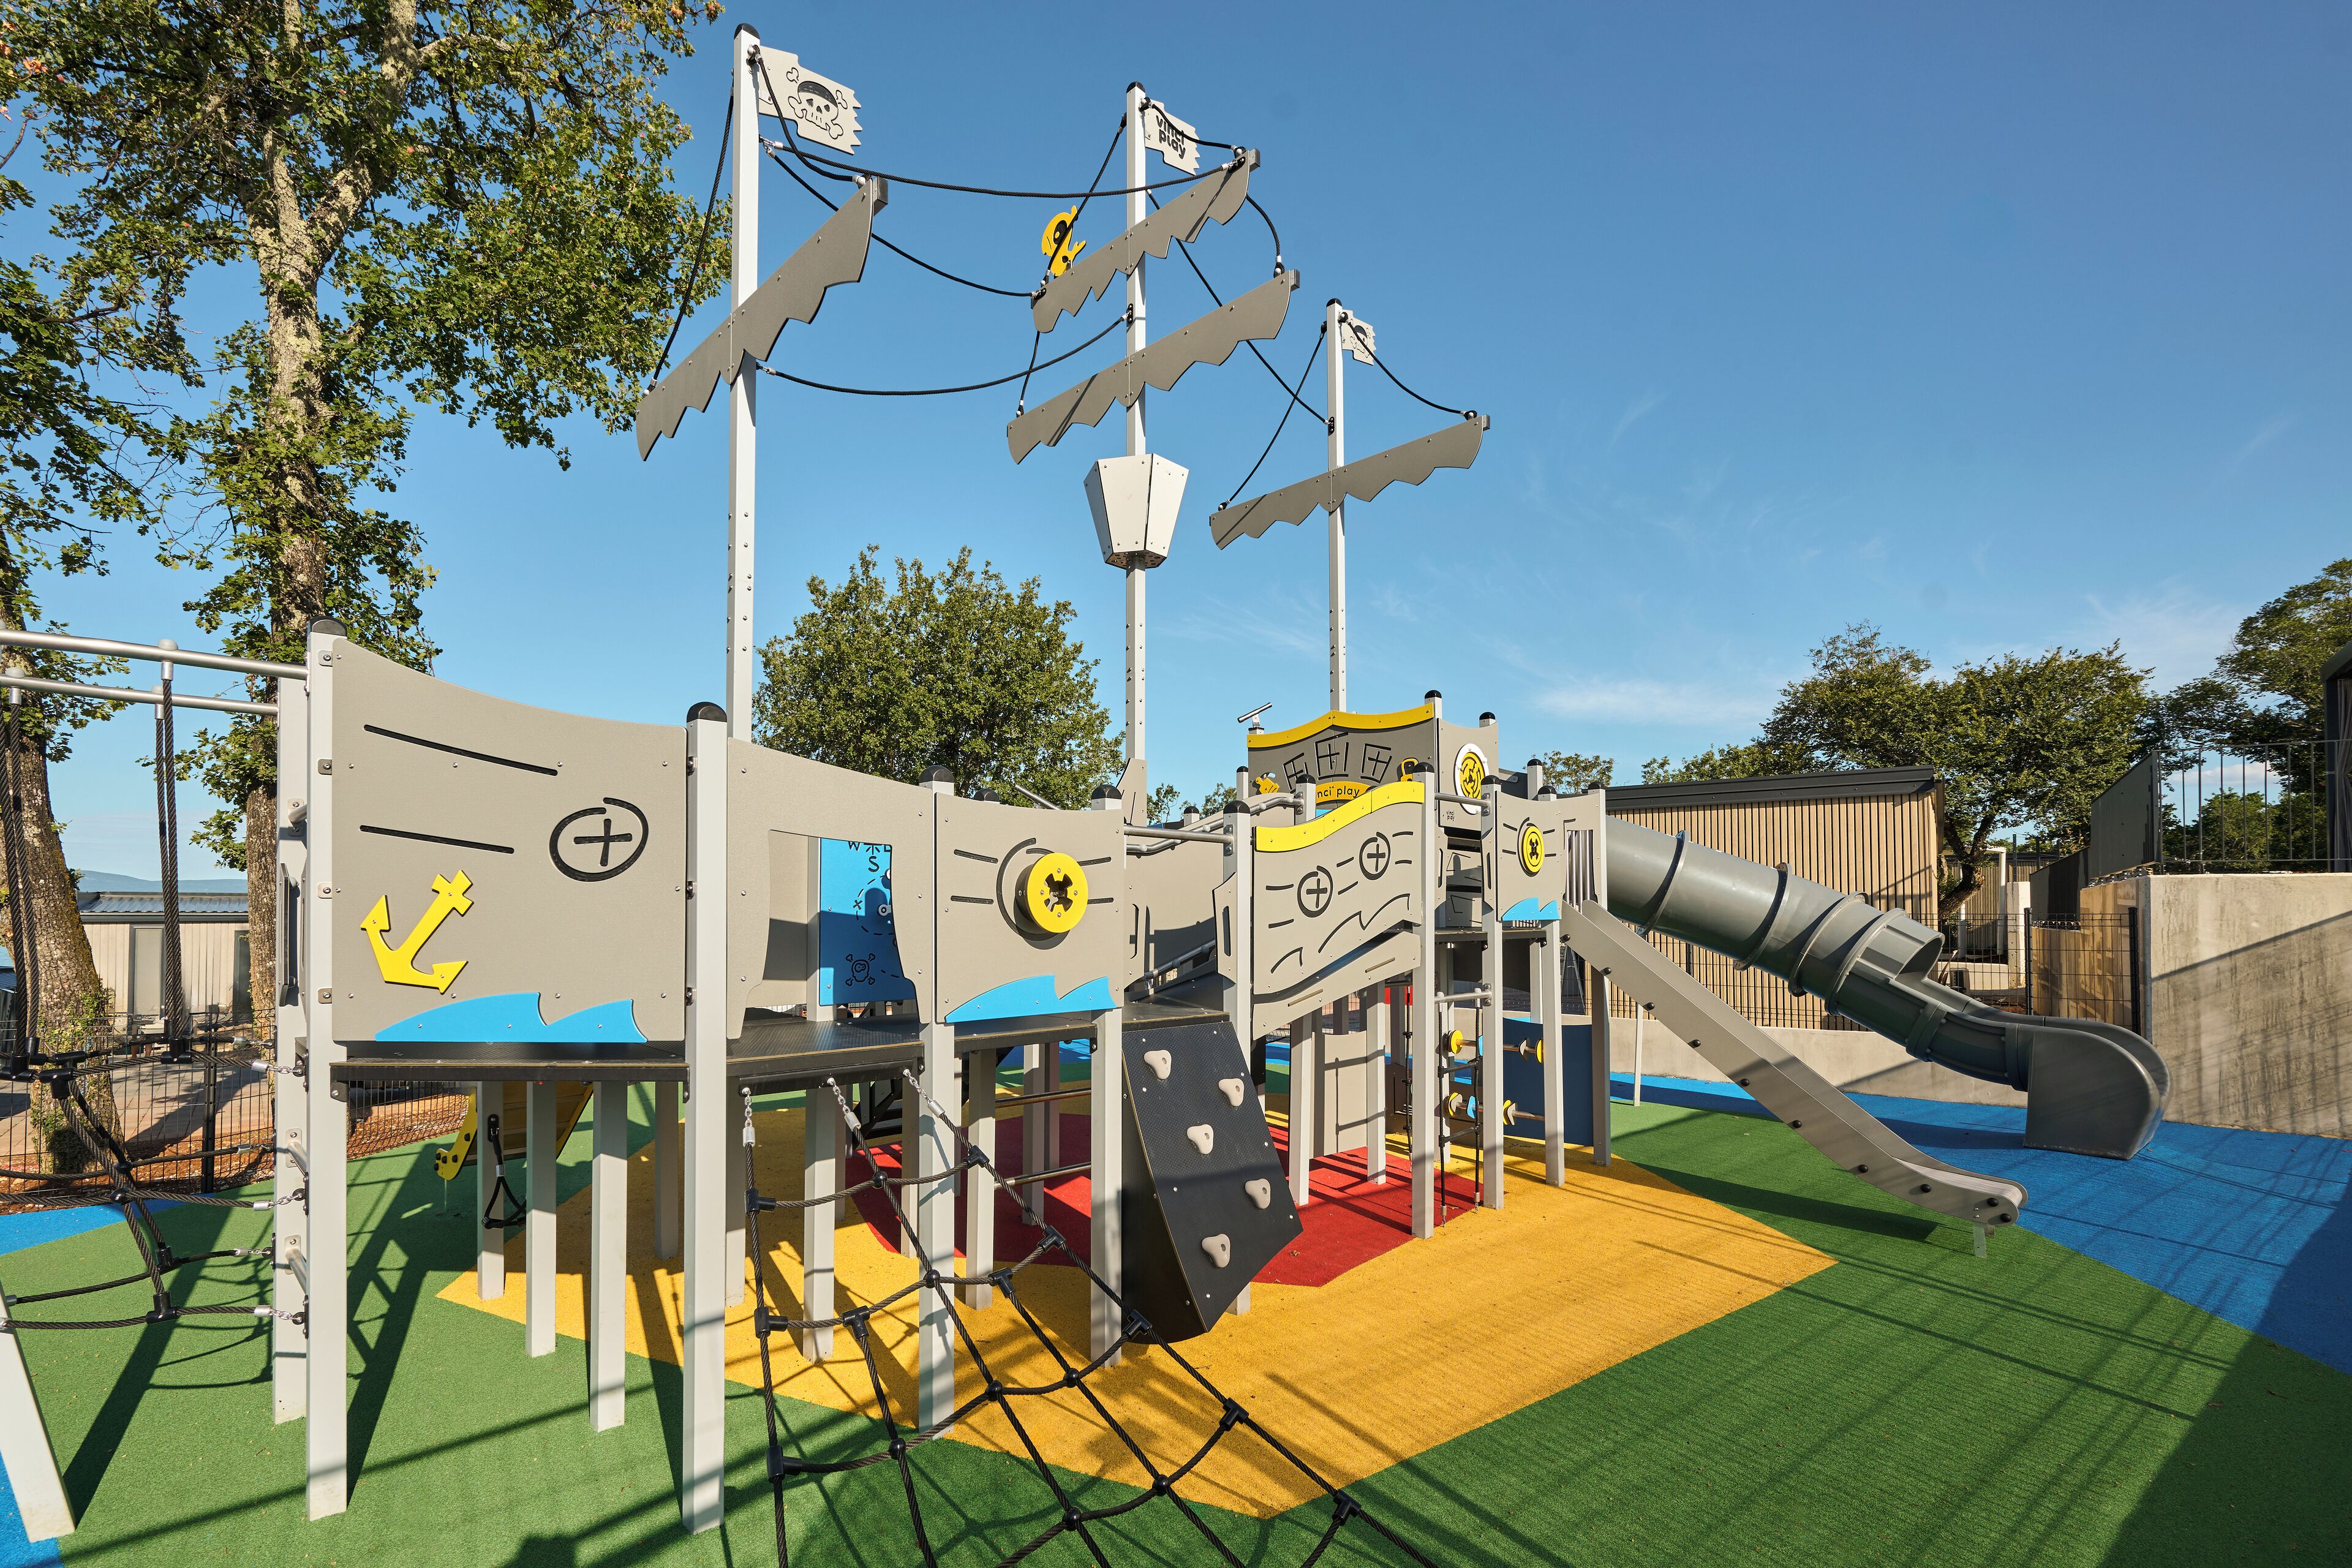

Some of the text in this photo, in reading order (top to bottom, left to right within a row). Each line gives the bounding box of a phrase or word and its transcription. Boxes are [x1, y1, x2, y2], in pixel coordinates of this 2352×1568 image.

[1156, 115, 1185, 145] vinci
[1159, 129, 1186, 159] play
[1317, 786, 1360, 798] nci play
[868, 856, 880, 872] S
